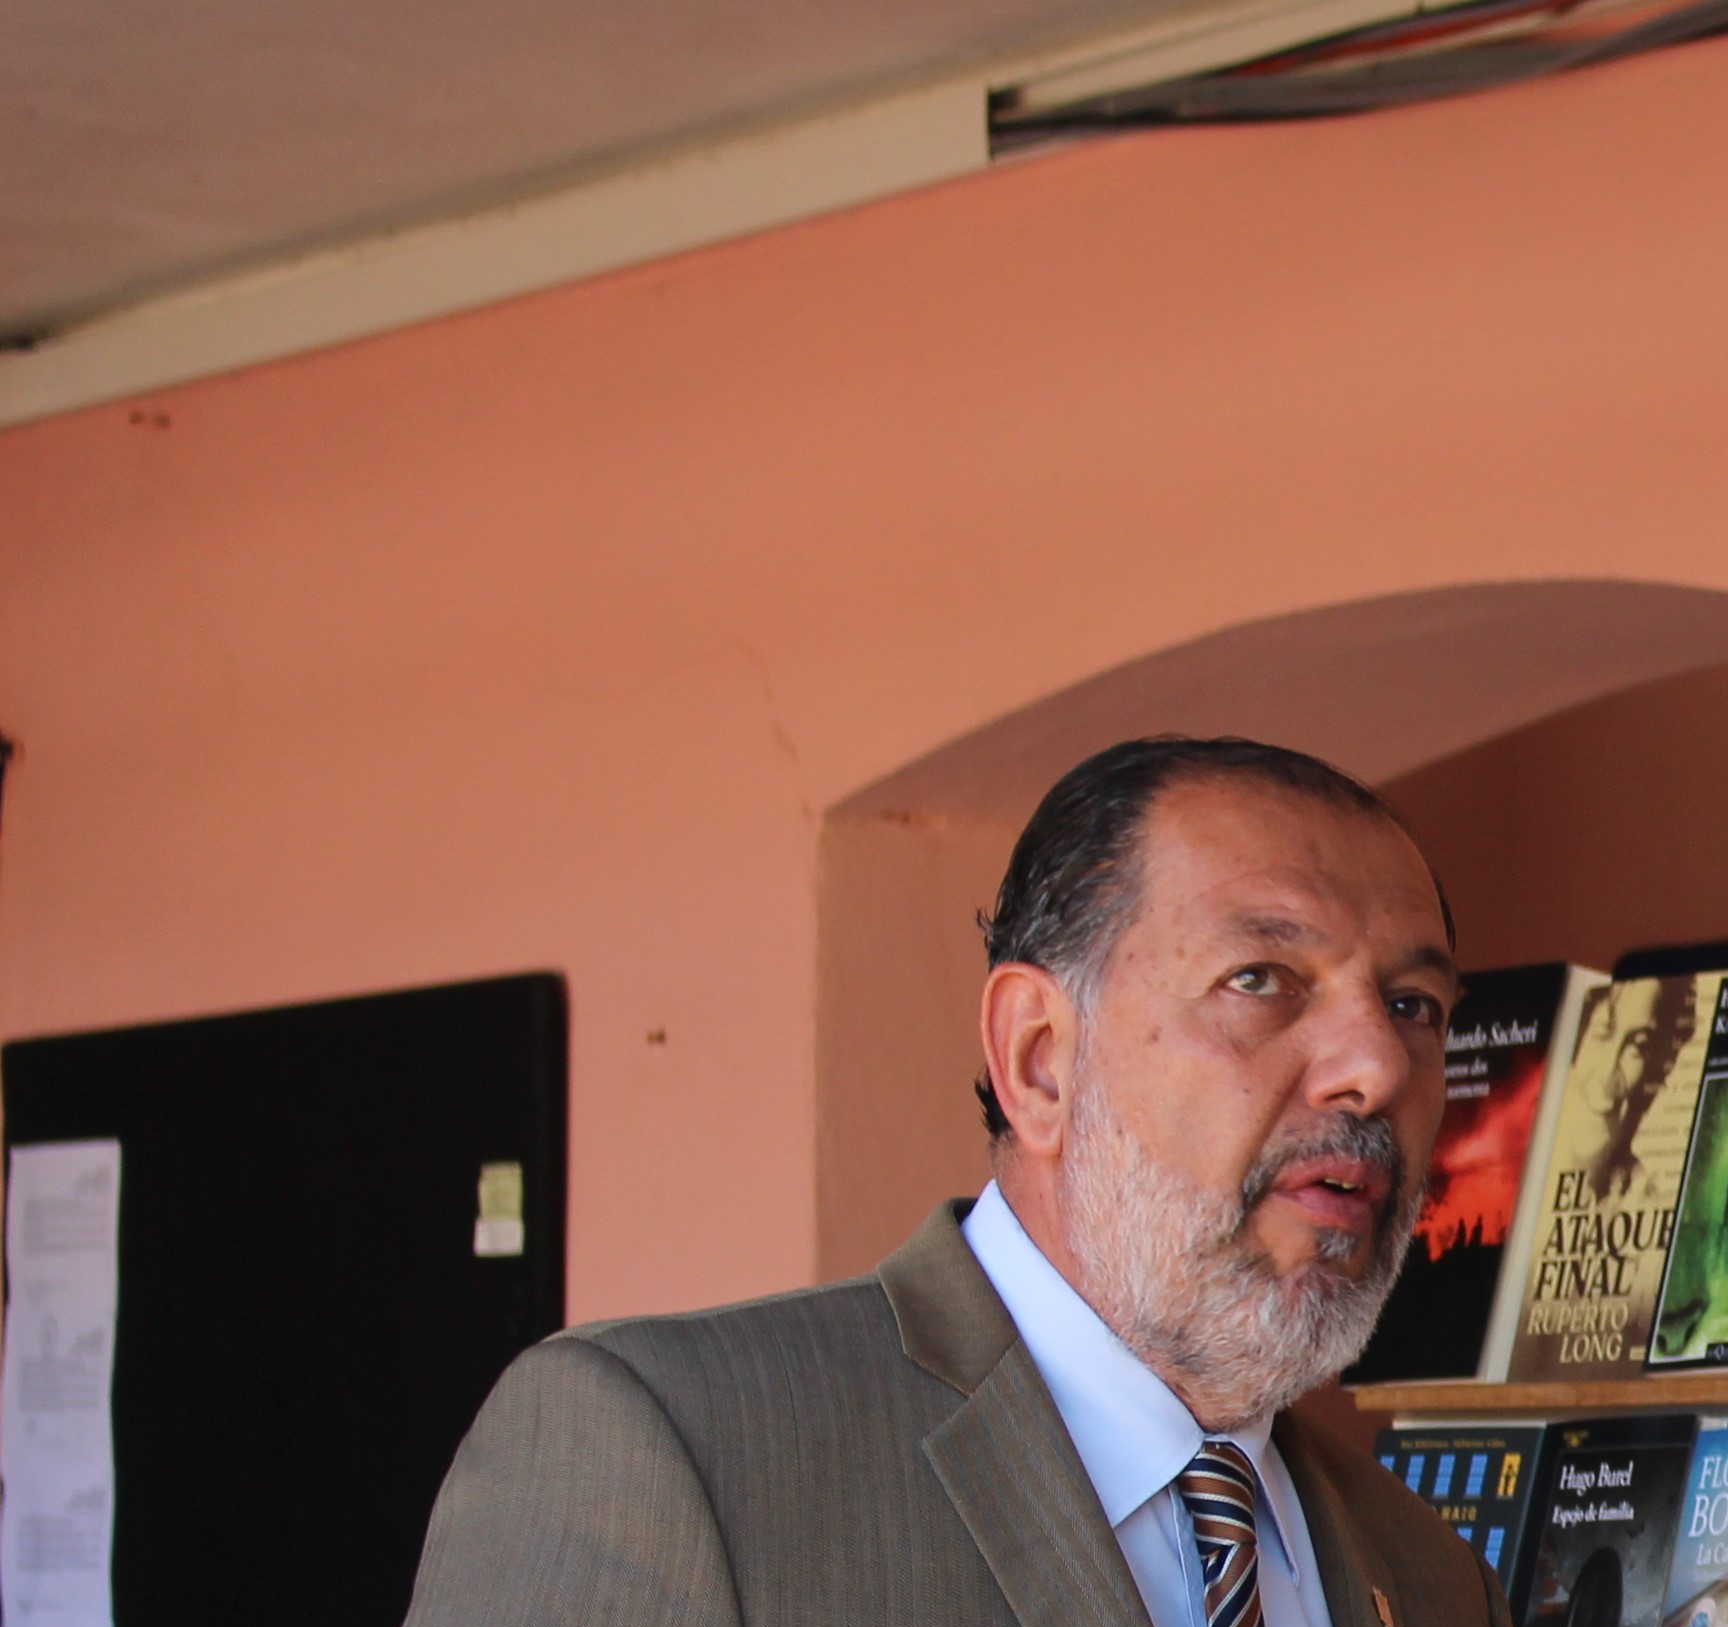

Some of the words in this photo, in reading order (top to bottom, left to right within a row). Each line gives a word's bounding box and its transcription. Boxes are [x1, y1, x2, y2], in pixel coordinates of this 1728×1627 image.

[1553, 1171, 1589, 1213] EL
[1543, 1209, 1674, 1258] ATAQUE
[1534, 1258, 1632, 1302] FINAL
[1526, 1303, 1629, 1337] RUPERTO
[1560, 1334, 1623, 1365] LONG
[1560, 1466, 1595, 1497] Hugo
[1598, 1460, 1634, 1488] Burel
